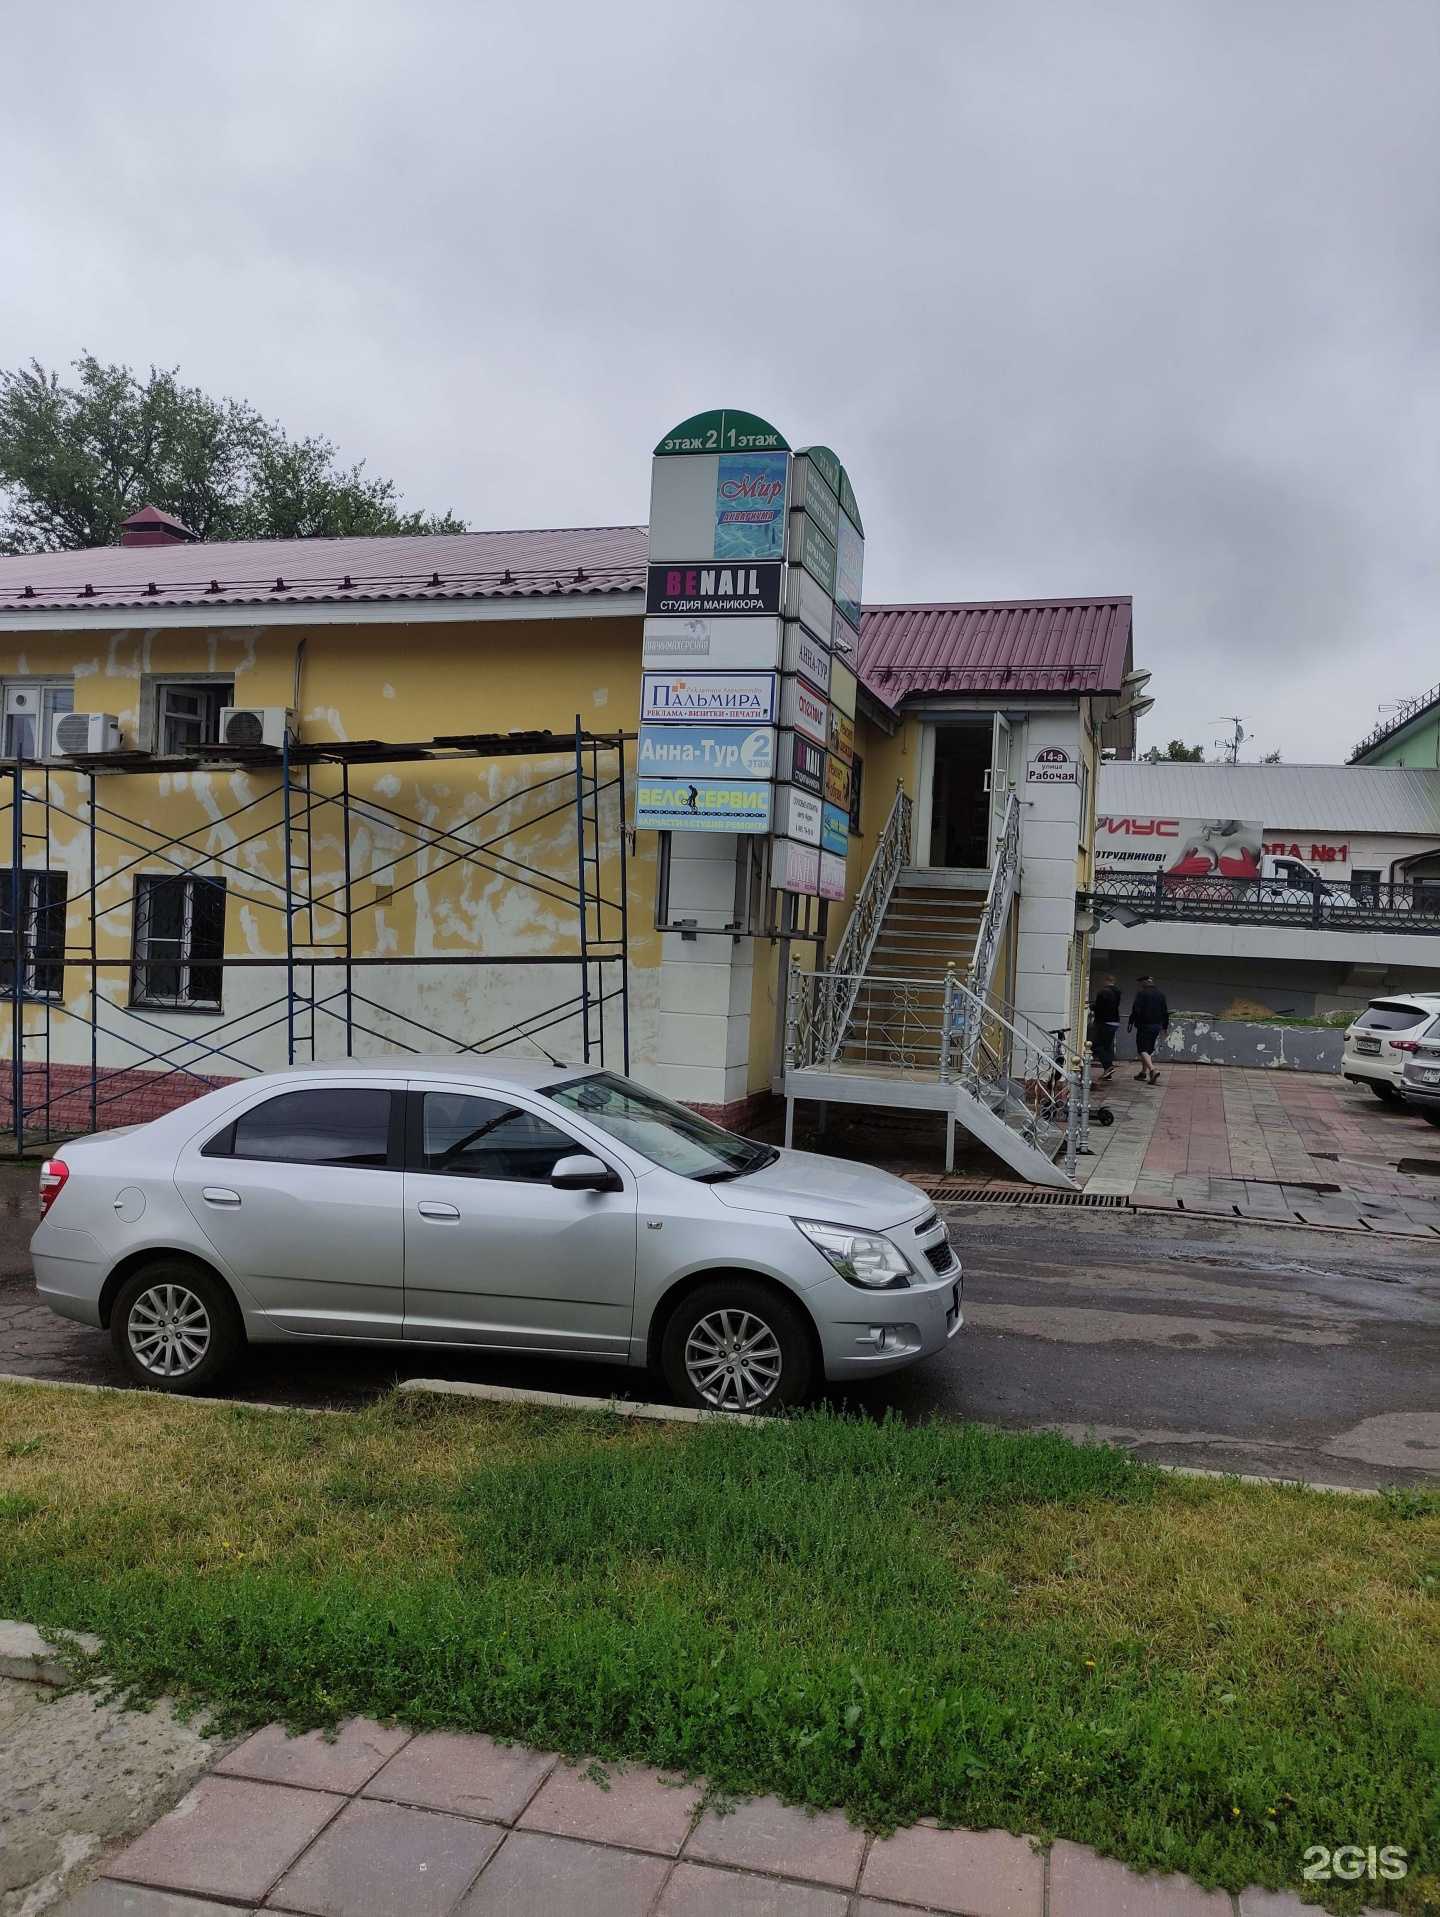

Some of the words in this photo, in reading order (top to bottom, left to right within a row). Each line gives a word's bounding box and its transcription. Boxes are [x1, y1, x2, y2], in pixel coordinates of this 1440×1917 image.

[664, 437, 702, 450] этаж
[706, 430, 718, 448] 2
[727, 429, 737, 447] 1
[738, 432, 778, 446] этаж
[720, 473, 784, 506] Мир
[660, 600, 702, 611] СТУДИЯ
[703, 599, 764, 610] МАНИКЮРА
[647, 709, 683, 717] РЕКЛАМА
[640, 738, 739, 768] Анна-Тур
[752, 734, 770, 757] 2
[1029, 770, 1074, 780] Рабочая
[1312, 844, 1348, 862] №1
